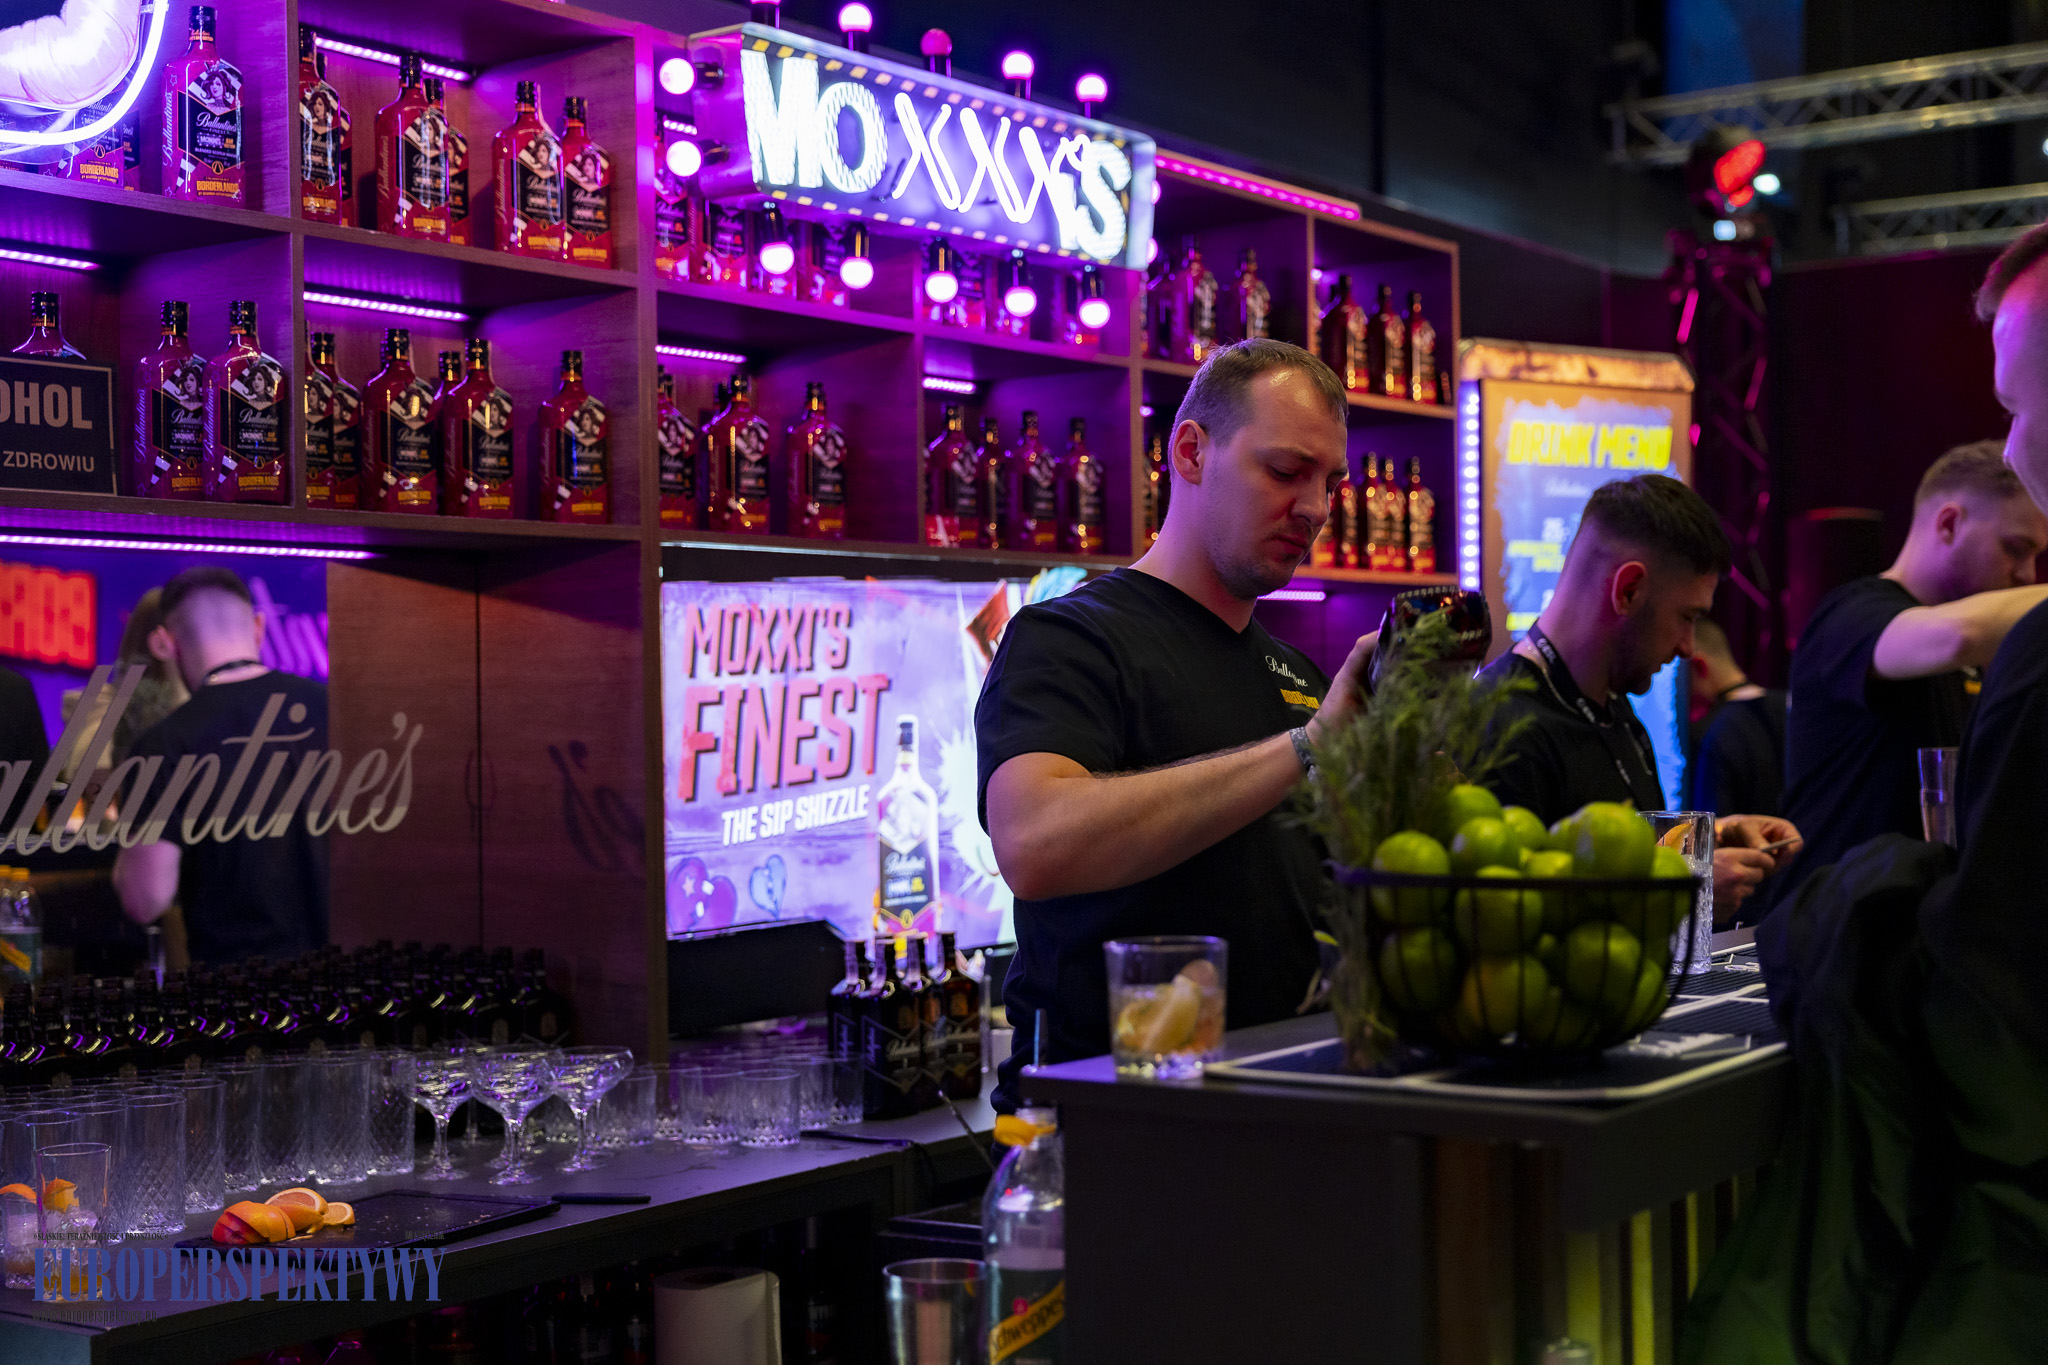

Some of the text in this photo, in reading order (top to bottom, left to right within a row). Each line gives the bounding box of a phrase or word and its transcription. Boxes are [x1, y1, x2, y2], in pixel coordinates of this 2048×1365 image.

[3, 450, 95, 473] ZDROWIU
[1507, 419, 1674, 471] DRINK MENU
[681, 601, 852, 678] MOXXI'S
[677, 672, 891, 803] FINEST
[721, 783, 870, 846] THE SIP SHIZZLE
